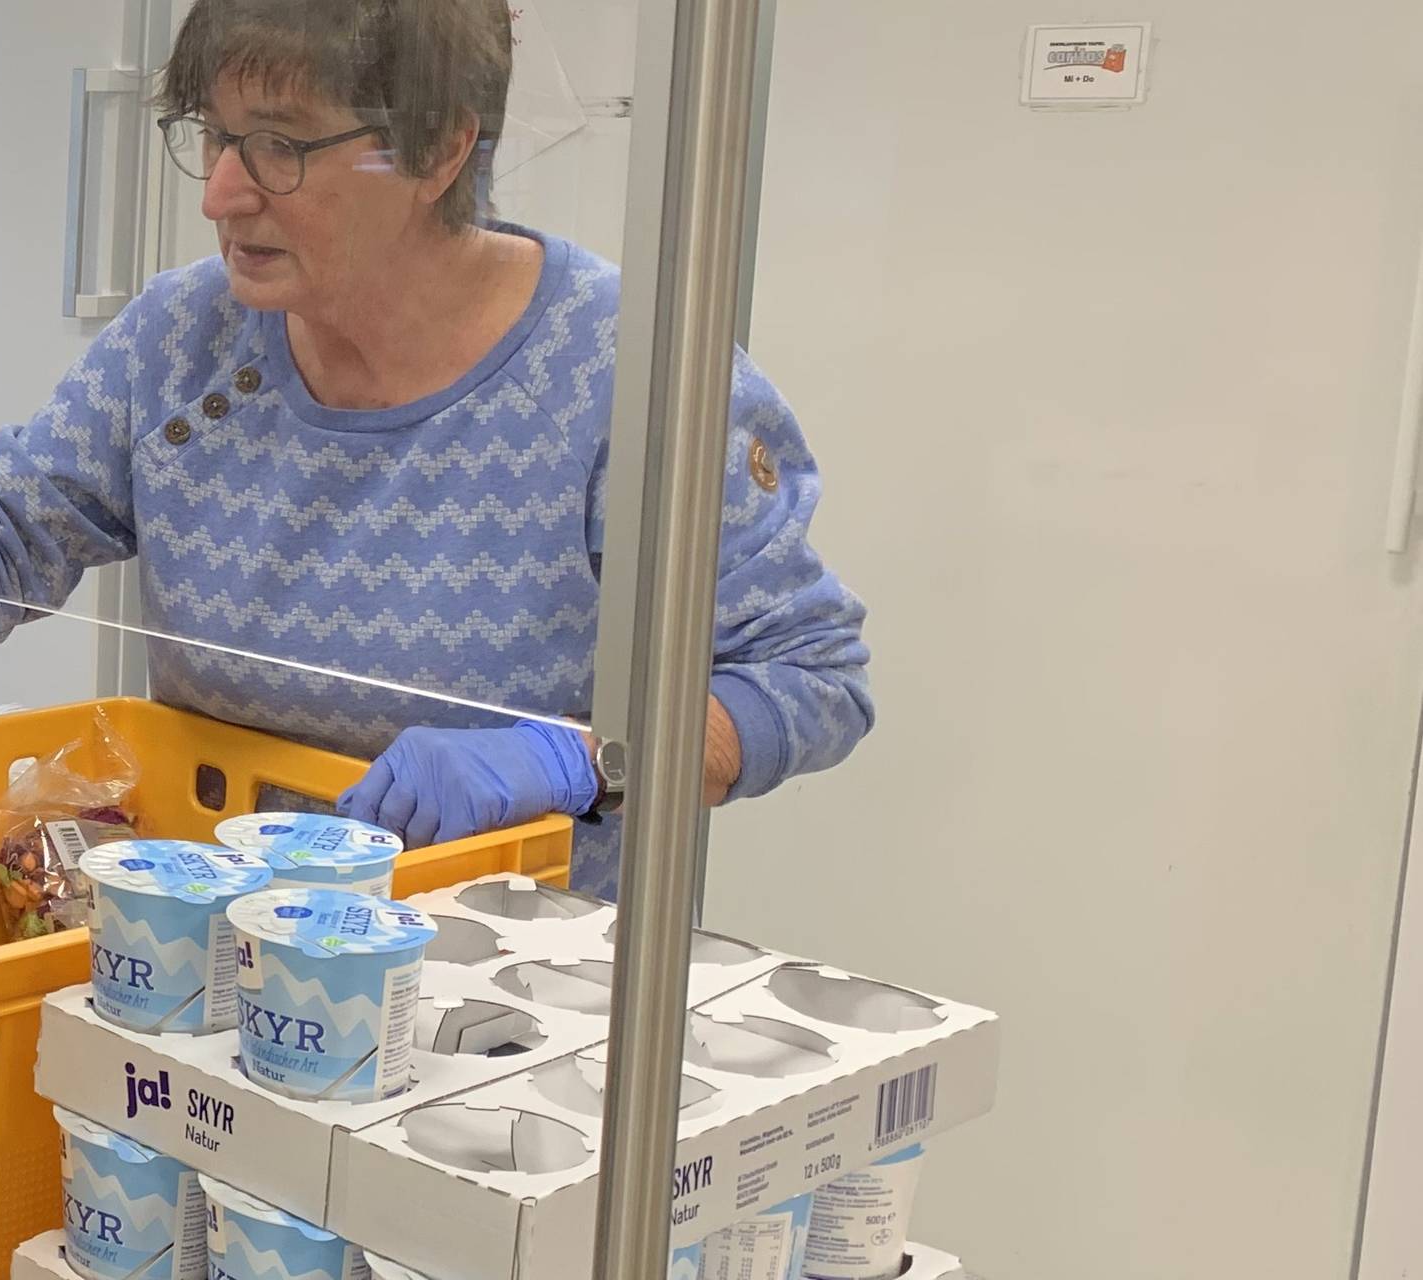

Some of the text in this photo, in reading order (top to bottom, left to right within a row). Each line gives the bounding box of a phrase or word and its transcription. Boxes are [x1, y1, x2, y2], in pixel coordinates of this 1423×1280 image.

[1047, 46, 1105, 64] caritas
[1064, 75, 1074, 83] Mi
[1082, 75, 1095, 83] Do
[310, 826, 350, 851] SKYR
[177, 852, 218, 880] SKYR
[339, 905, 374, 937] SKYR
[385, 911, 425, 927] ja!
[91, 942, 155, 991] KYR
[237, 941, 254, 970] a!
[251, 1058, 286, 1083] Natur
[299, 1057, 319, 1074] Art
[124, 1061, 235, 1135] ja! SKYR
[185, 1122, 221, 1153] Natur
[803, 1163, 813, 1180] 12
[814, 1163, 820, 1176] x
[64, 1190, 124, 1246] KYR
